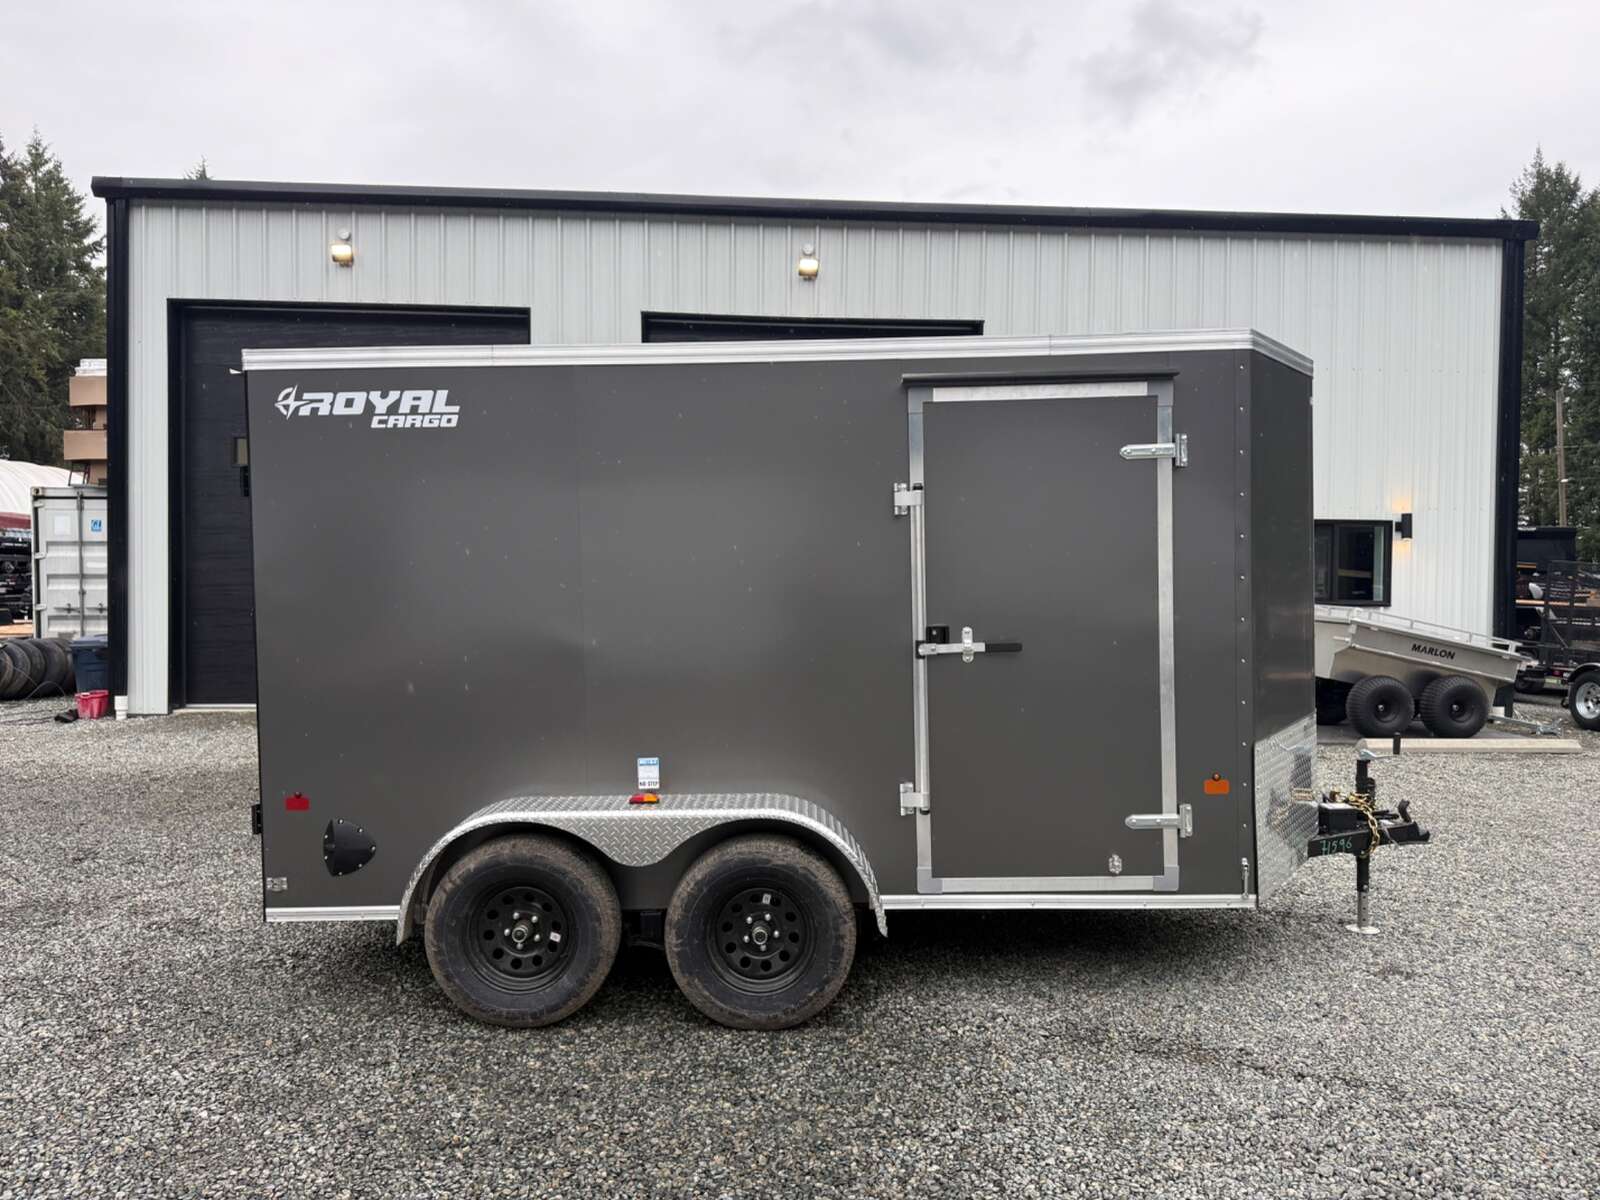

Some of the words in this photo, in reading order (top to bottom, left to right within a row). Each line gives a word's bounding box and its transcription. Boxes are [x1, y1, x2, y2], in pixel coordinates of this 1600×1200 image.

[298, 390, 461, 416] ROYAL
[370, 414, 459, 428] CARGO
[1411, 643, 1456, 660] MARLON
